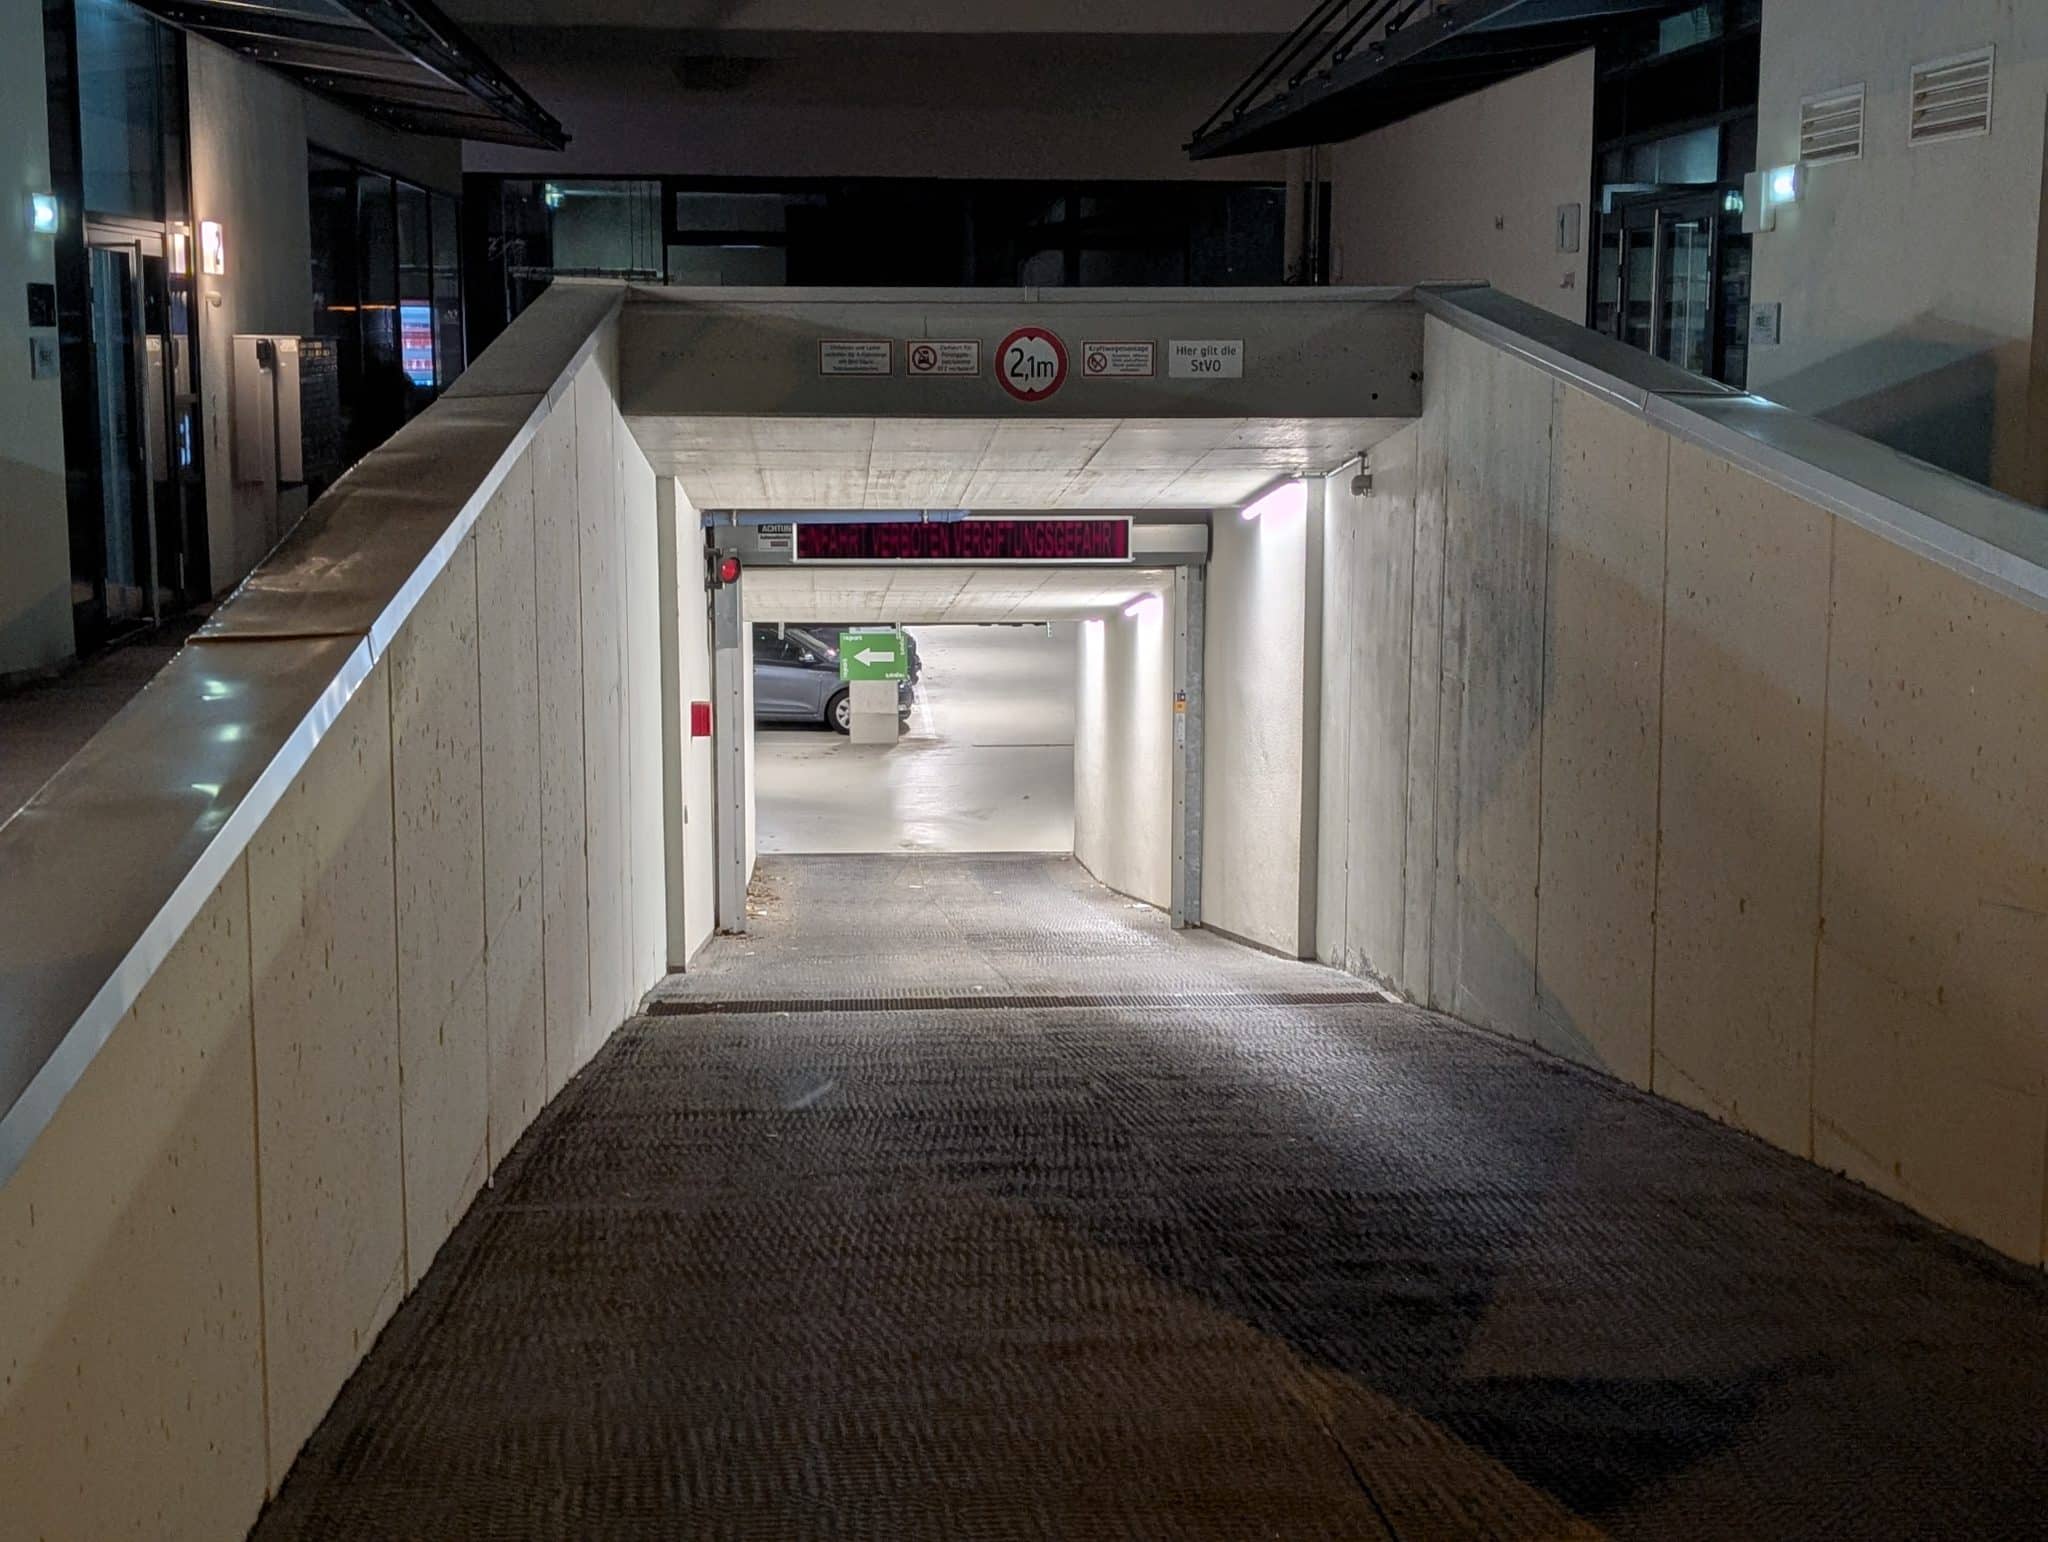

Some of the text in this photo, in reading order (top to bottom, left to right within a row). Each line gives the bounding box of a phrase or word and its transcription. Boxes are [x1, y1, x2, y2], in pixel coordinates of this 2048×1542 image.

[1176, 345, 1237, 357] Hier gilt die
[1010, 347, 1054, 381] 2,1m
[1191, 359, 1221, 372] StVO
[873, 524, 949, 555] VERBOTEN
[954, 522, 1112, 555] VERGIFTUNGSGEFAHR
